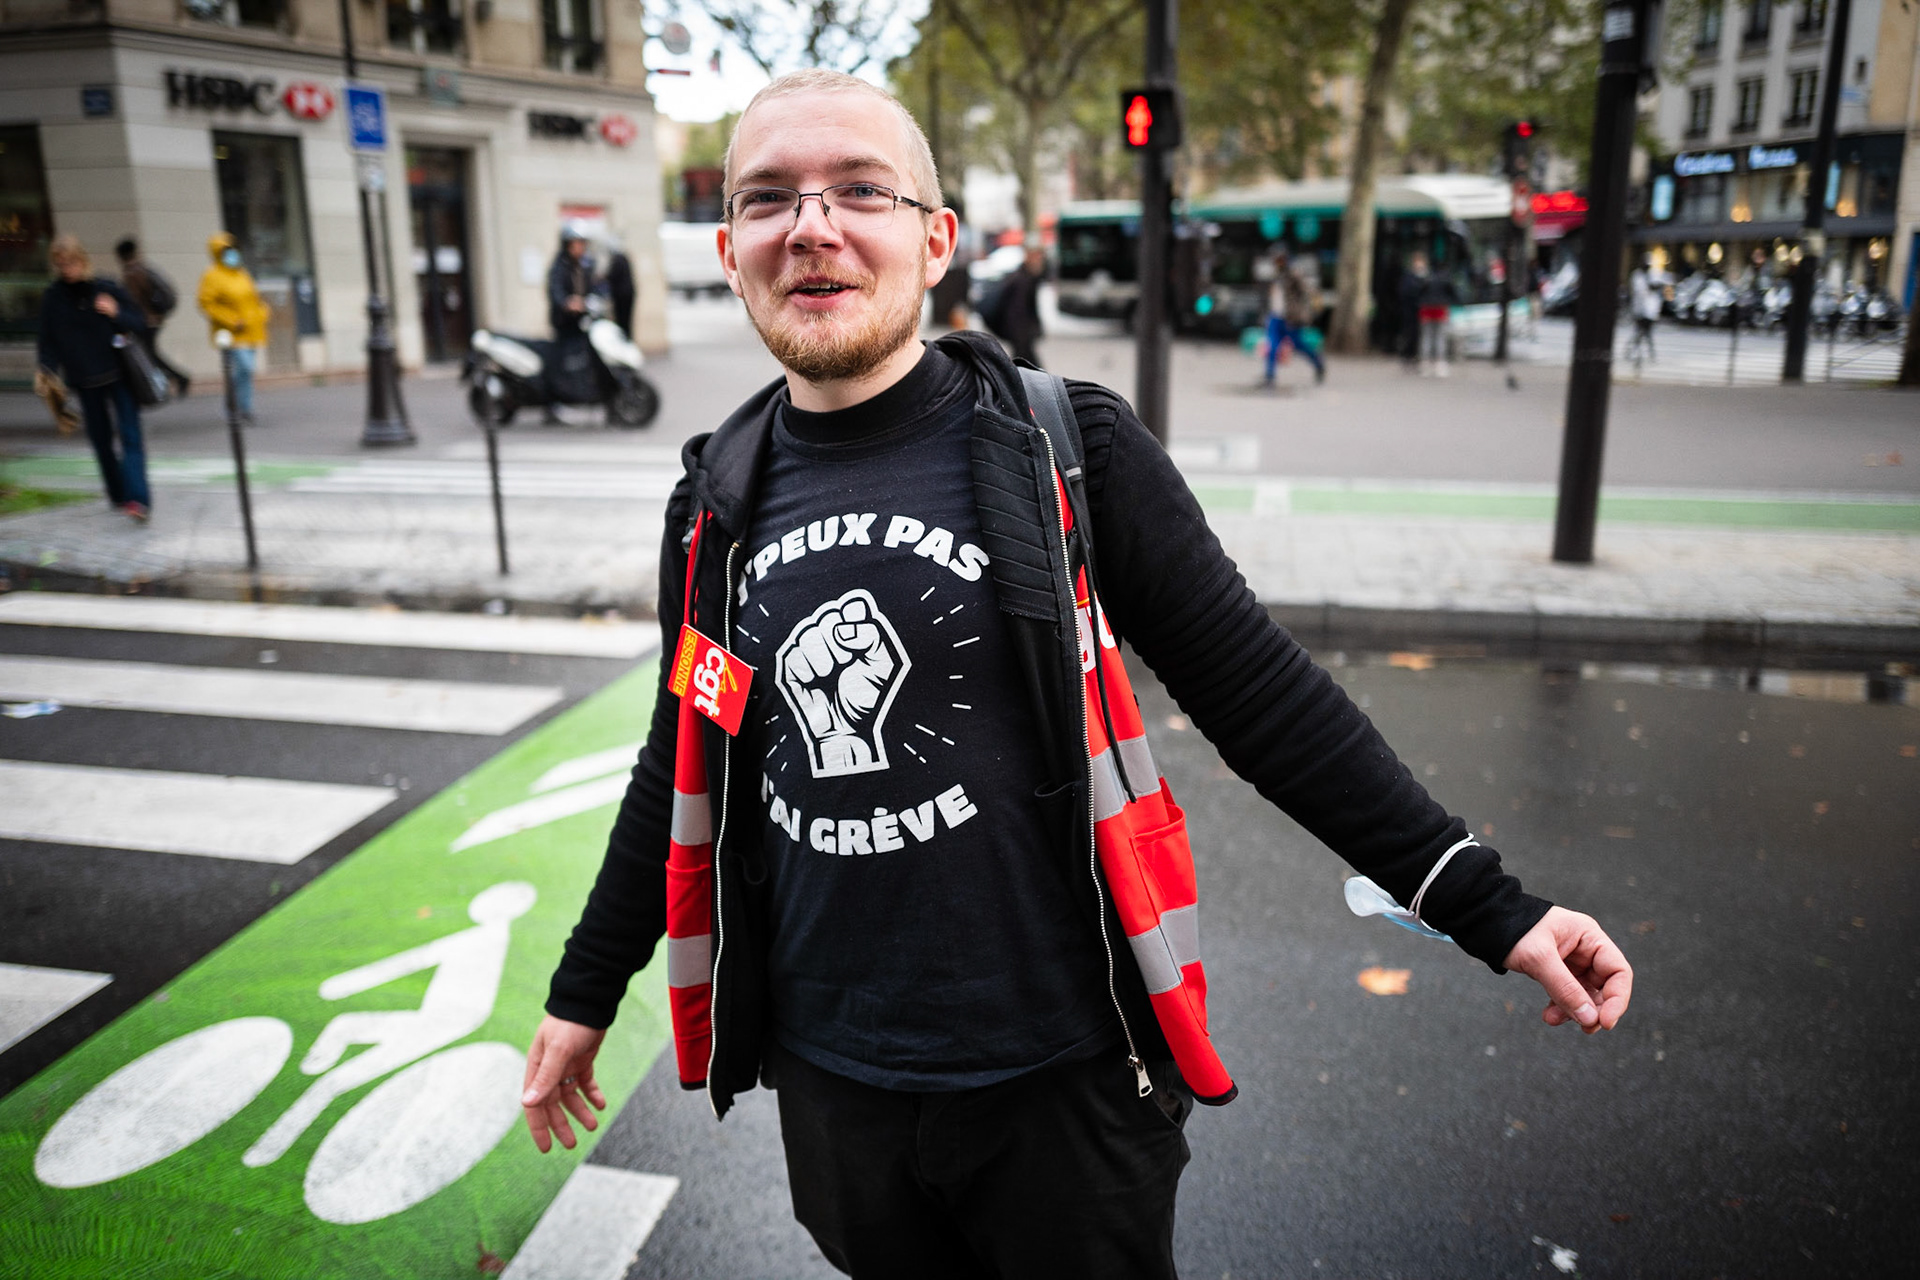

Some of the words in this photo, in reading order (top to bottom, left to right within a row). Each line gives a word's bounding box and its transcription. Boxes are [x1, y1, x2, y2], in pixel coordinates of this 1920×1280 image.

[163, 71, 277, 115] HSBC
[883, 515, 990, 582] PAS
[673, 630, 697, 696] ESSONNE
[694, 647, 725, 717] cgt
[809, 783, 978, 856] GRÈVE
